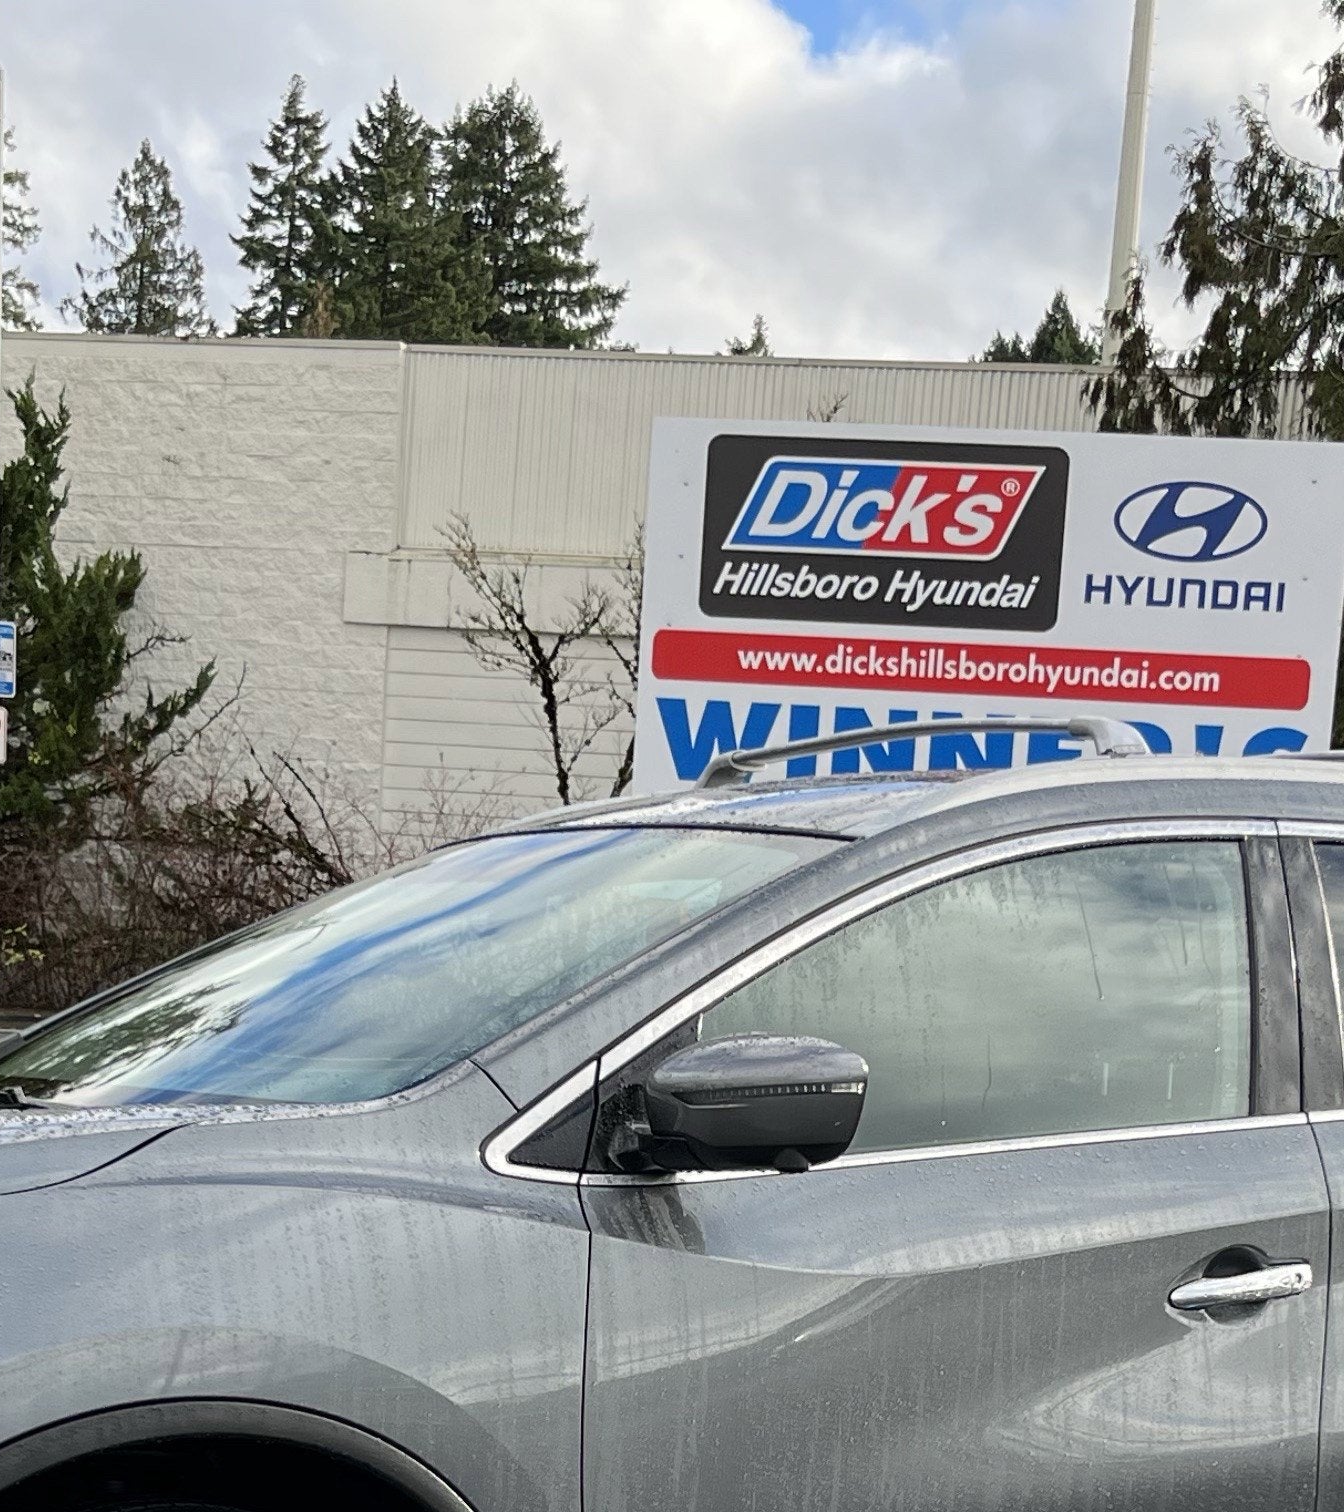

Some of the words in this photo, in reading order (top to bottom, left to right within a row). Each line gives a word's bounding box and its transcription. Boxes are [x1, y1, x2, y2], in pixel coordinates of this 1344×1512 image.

[748, 469, 1003, 545] Dick's
[712, 562, 880, 602] Hillsboro
[885, 572, 1041, 611] Hyundai
[1084, 574, 1286, 613] HYUNDAI
[737, 642, 1222, 695] www.dickshillsborohyundai.com
